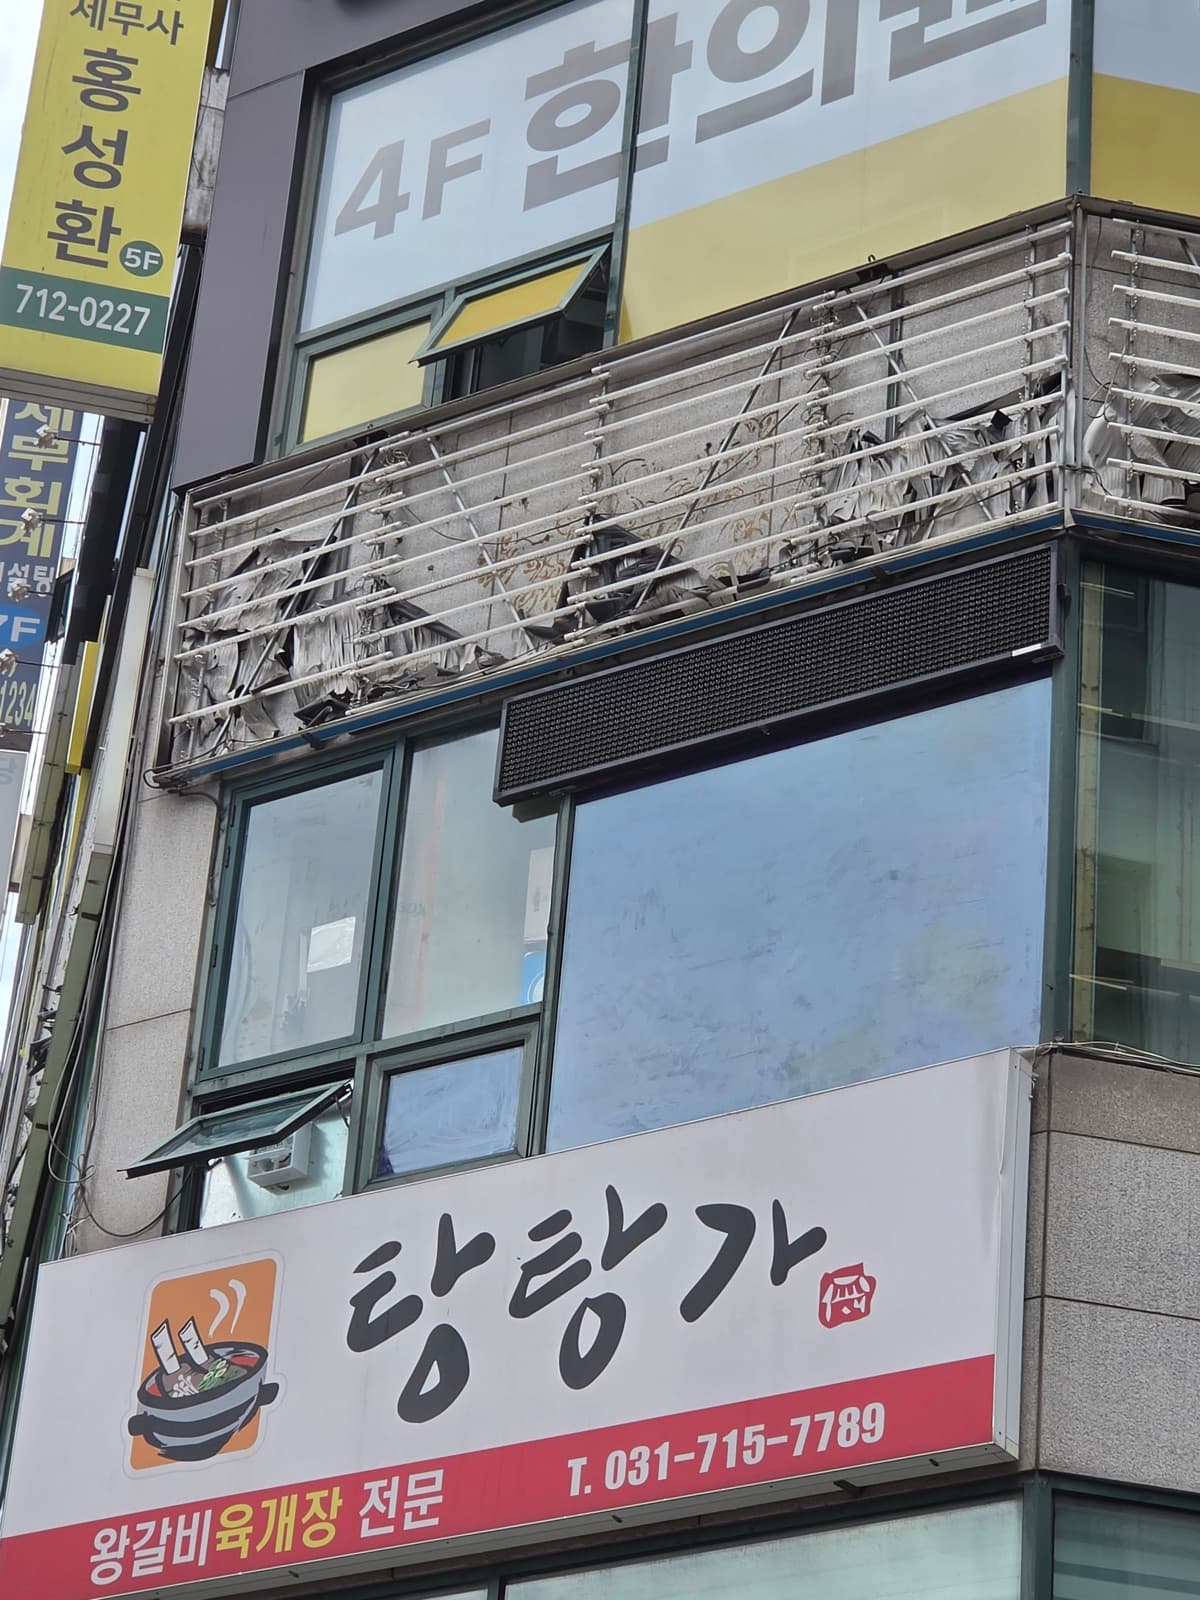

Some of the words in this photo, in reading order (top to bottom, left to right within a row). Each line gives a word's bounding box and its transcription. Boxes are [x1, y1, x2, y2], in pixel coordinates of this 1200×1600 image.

[70, 0, 184, 45] 세무사
[47, 47, 142, 269] 홍성환
[334, 119, 491, 240] 4F
[124, 248, 161, 271] 5F
[16, 283, 151, 337] 712-0227
[0, 402, 74, 558] 세무회계
[0, 561, 55, 599] 설팅
[346, 1184, 827, 1424] 탕탕가
[567, 1456, 592, 1497] T.
[604, 1402, 886, 1490] 031-715-7789
[359, 1469, 444, 1538] 전문
